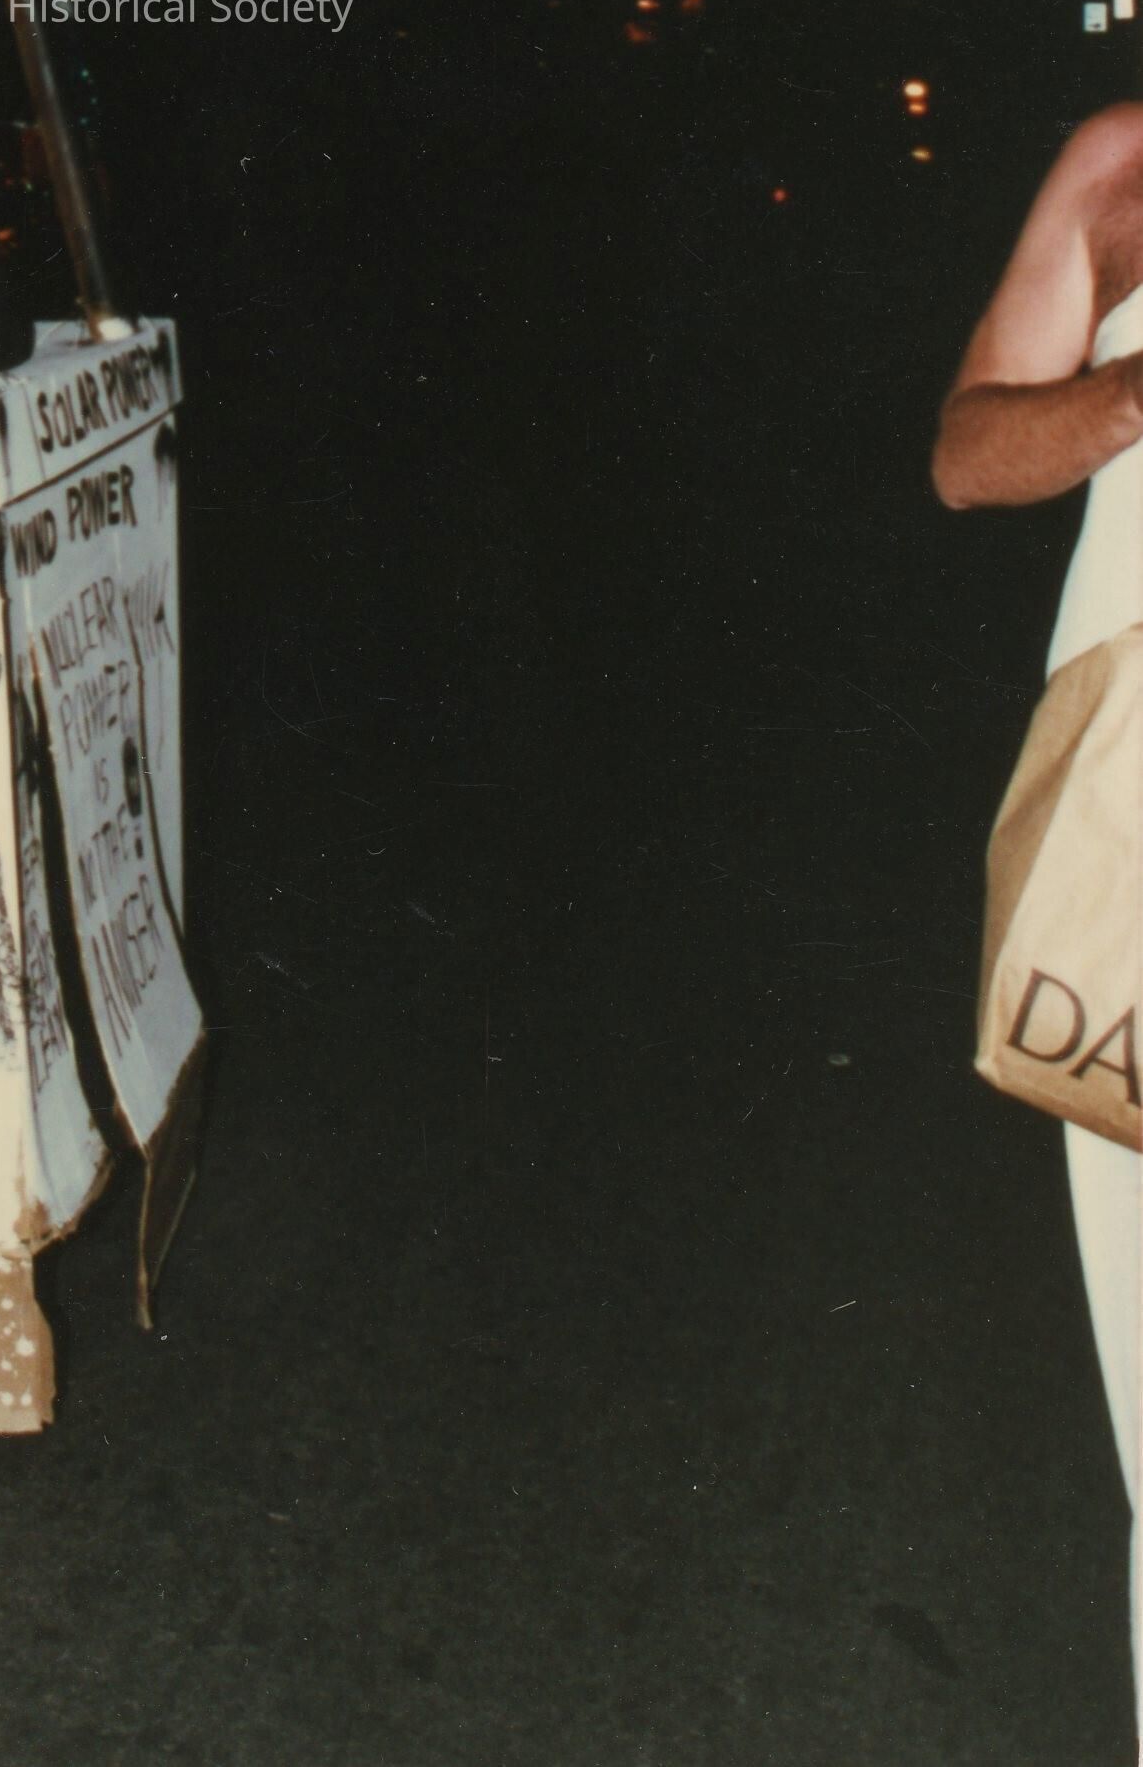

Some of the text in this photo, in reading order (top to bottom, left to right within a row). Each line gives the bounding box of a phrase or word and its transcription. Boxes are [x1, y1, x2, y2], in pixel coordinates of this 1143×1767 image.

[37, 368, 108, 453] SOLAR
[66, 463, 138, 542] POWER
[41, 576, 124, 689] NUCLEAR
[60, 659, 131, 770] POWER
[93, 756, 109, 805] IS
[1006, 966, 1143, 1110] DA
